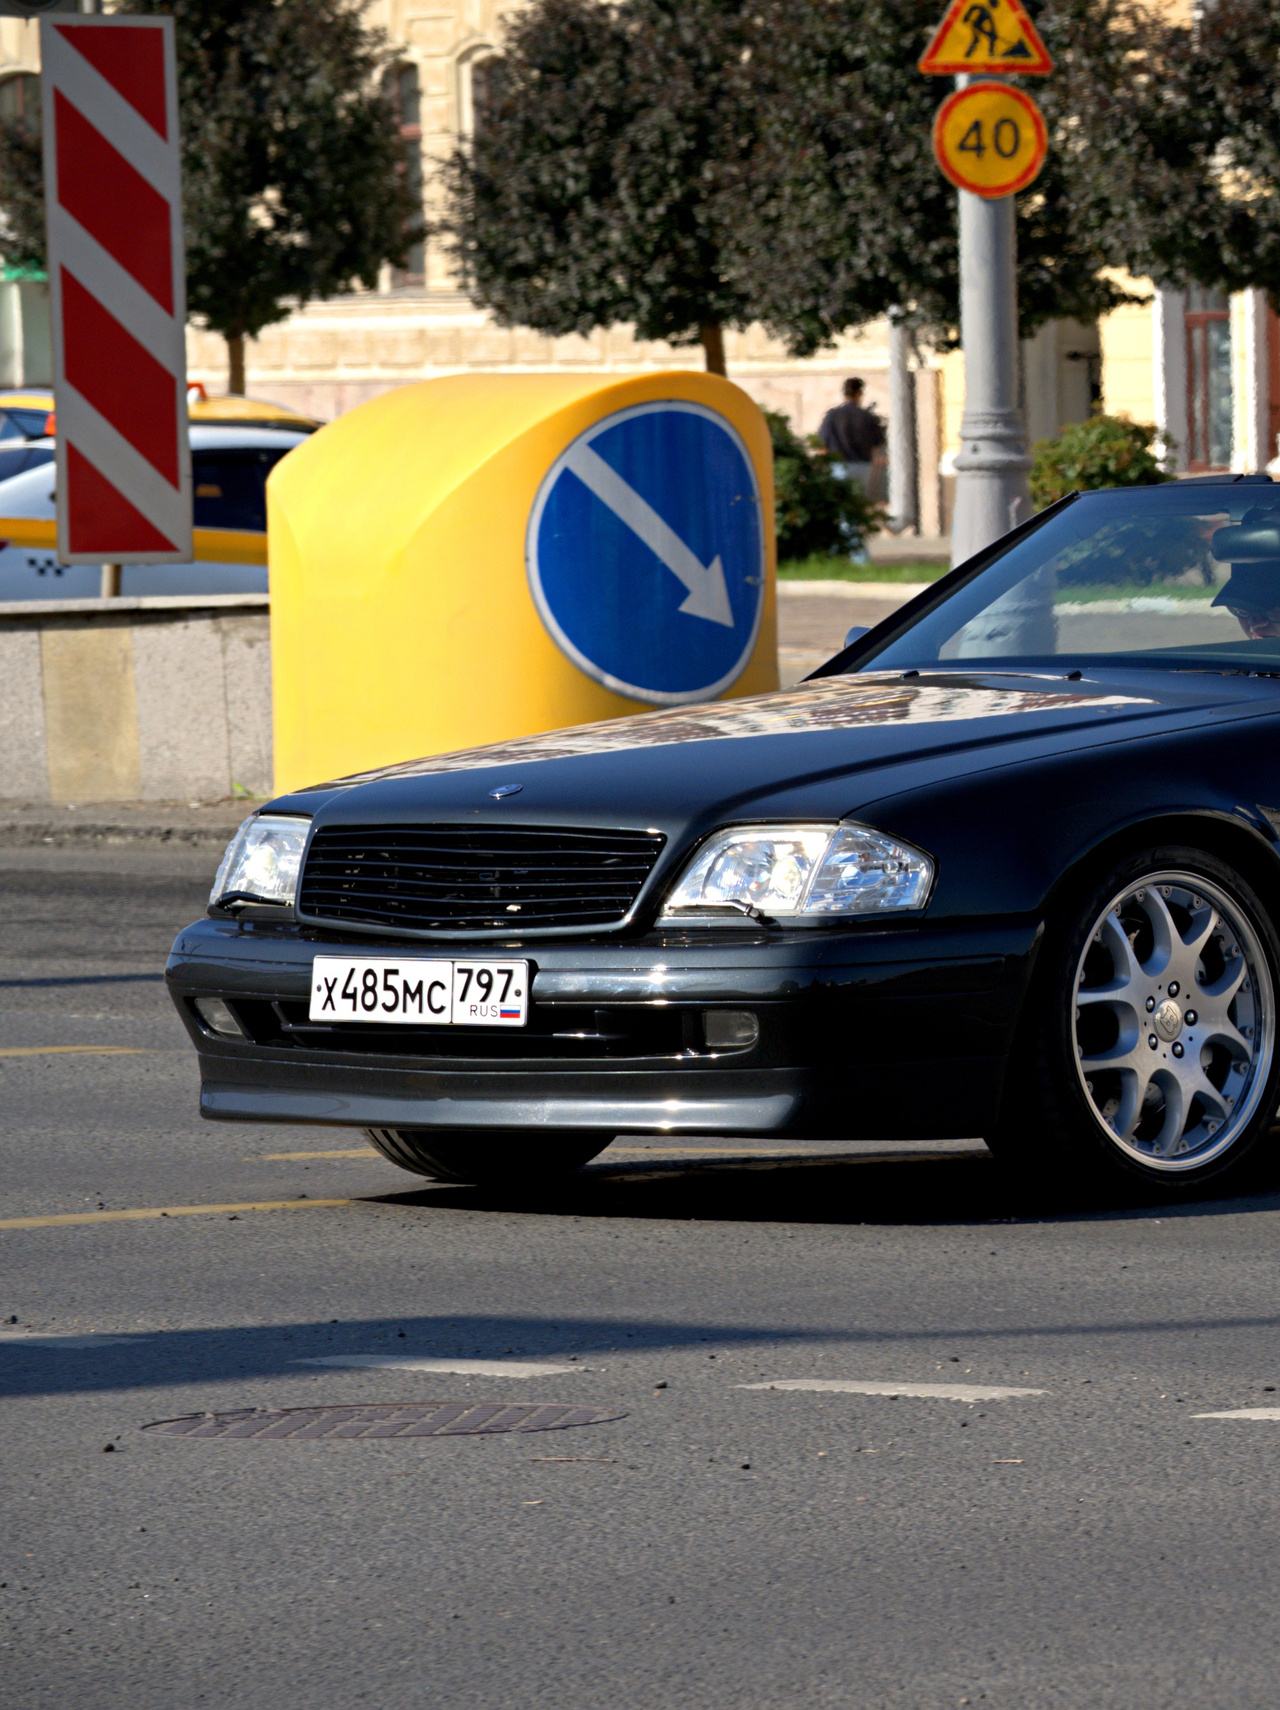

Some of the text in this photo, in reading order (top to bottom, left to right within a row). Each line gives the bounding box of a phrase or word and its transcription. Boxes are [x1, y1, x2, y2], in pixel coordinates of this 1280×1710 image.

[957, 117, 1020, 158] 40
[321, 967, 514, 1014] Х485МС 797
[469, 1004, 498, 1018] RUS
